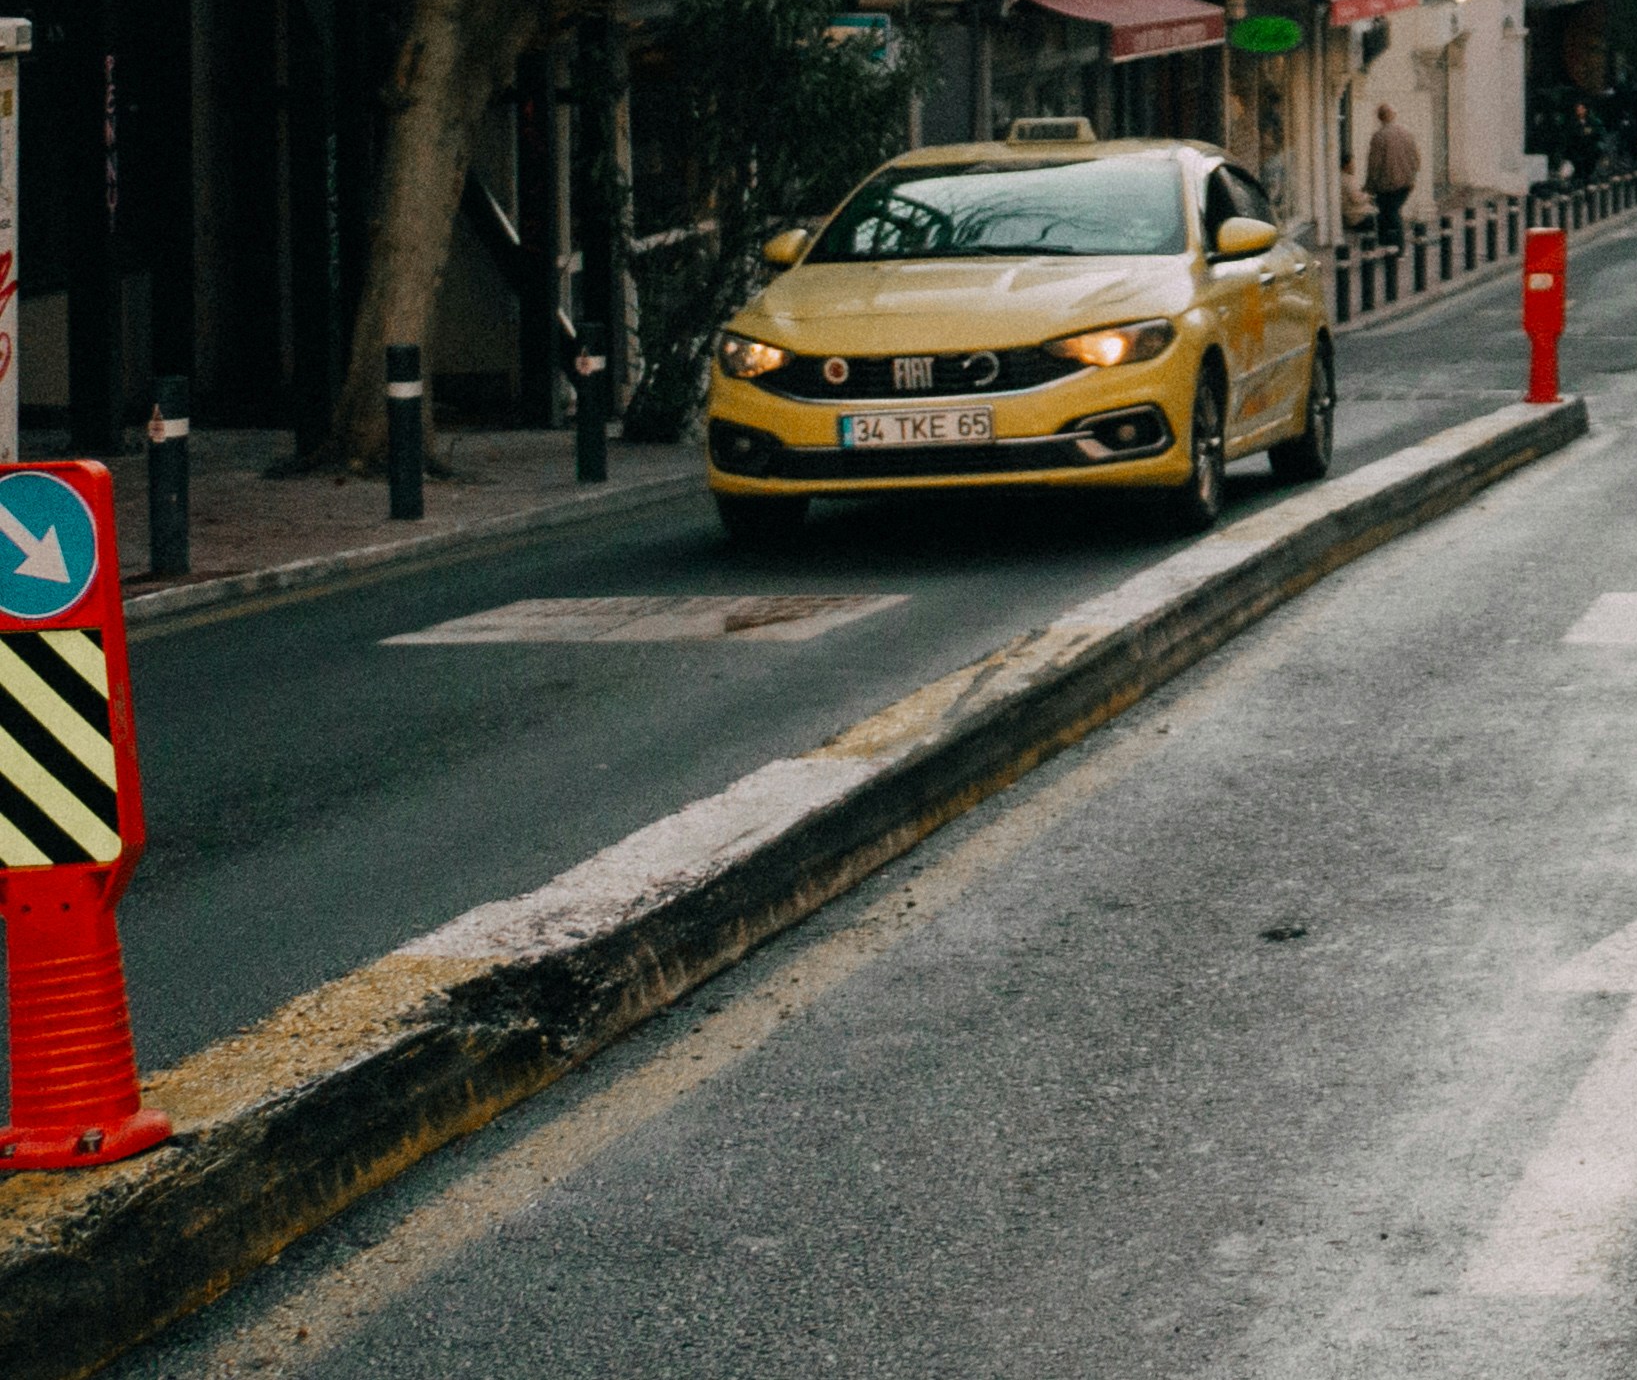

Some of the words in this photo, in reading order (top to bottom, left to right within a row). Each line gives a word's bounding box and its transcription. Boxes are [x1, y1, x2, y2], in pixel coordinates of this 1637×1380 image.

[893, 356, 935, 390] FIAT
[856, 420, 884, 442] 34
[894, 414, 947, 440] TKE
[957, 413, 988, 437] 65
